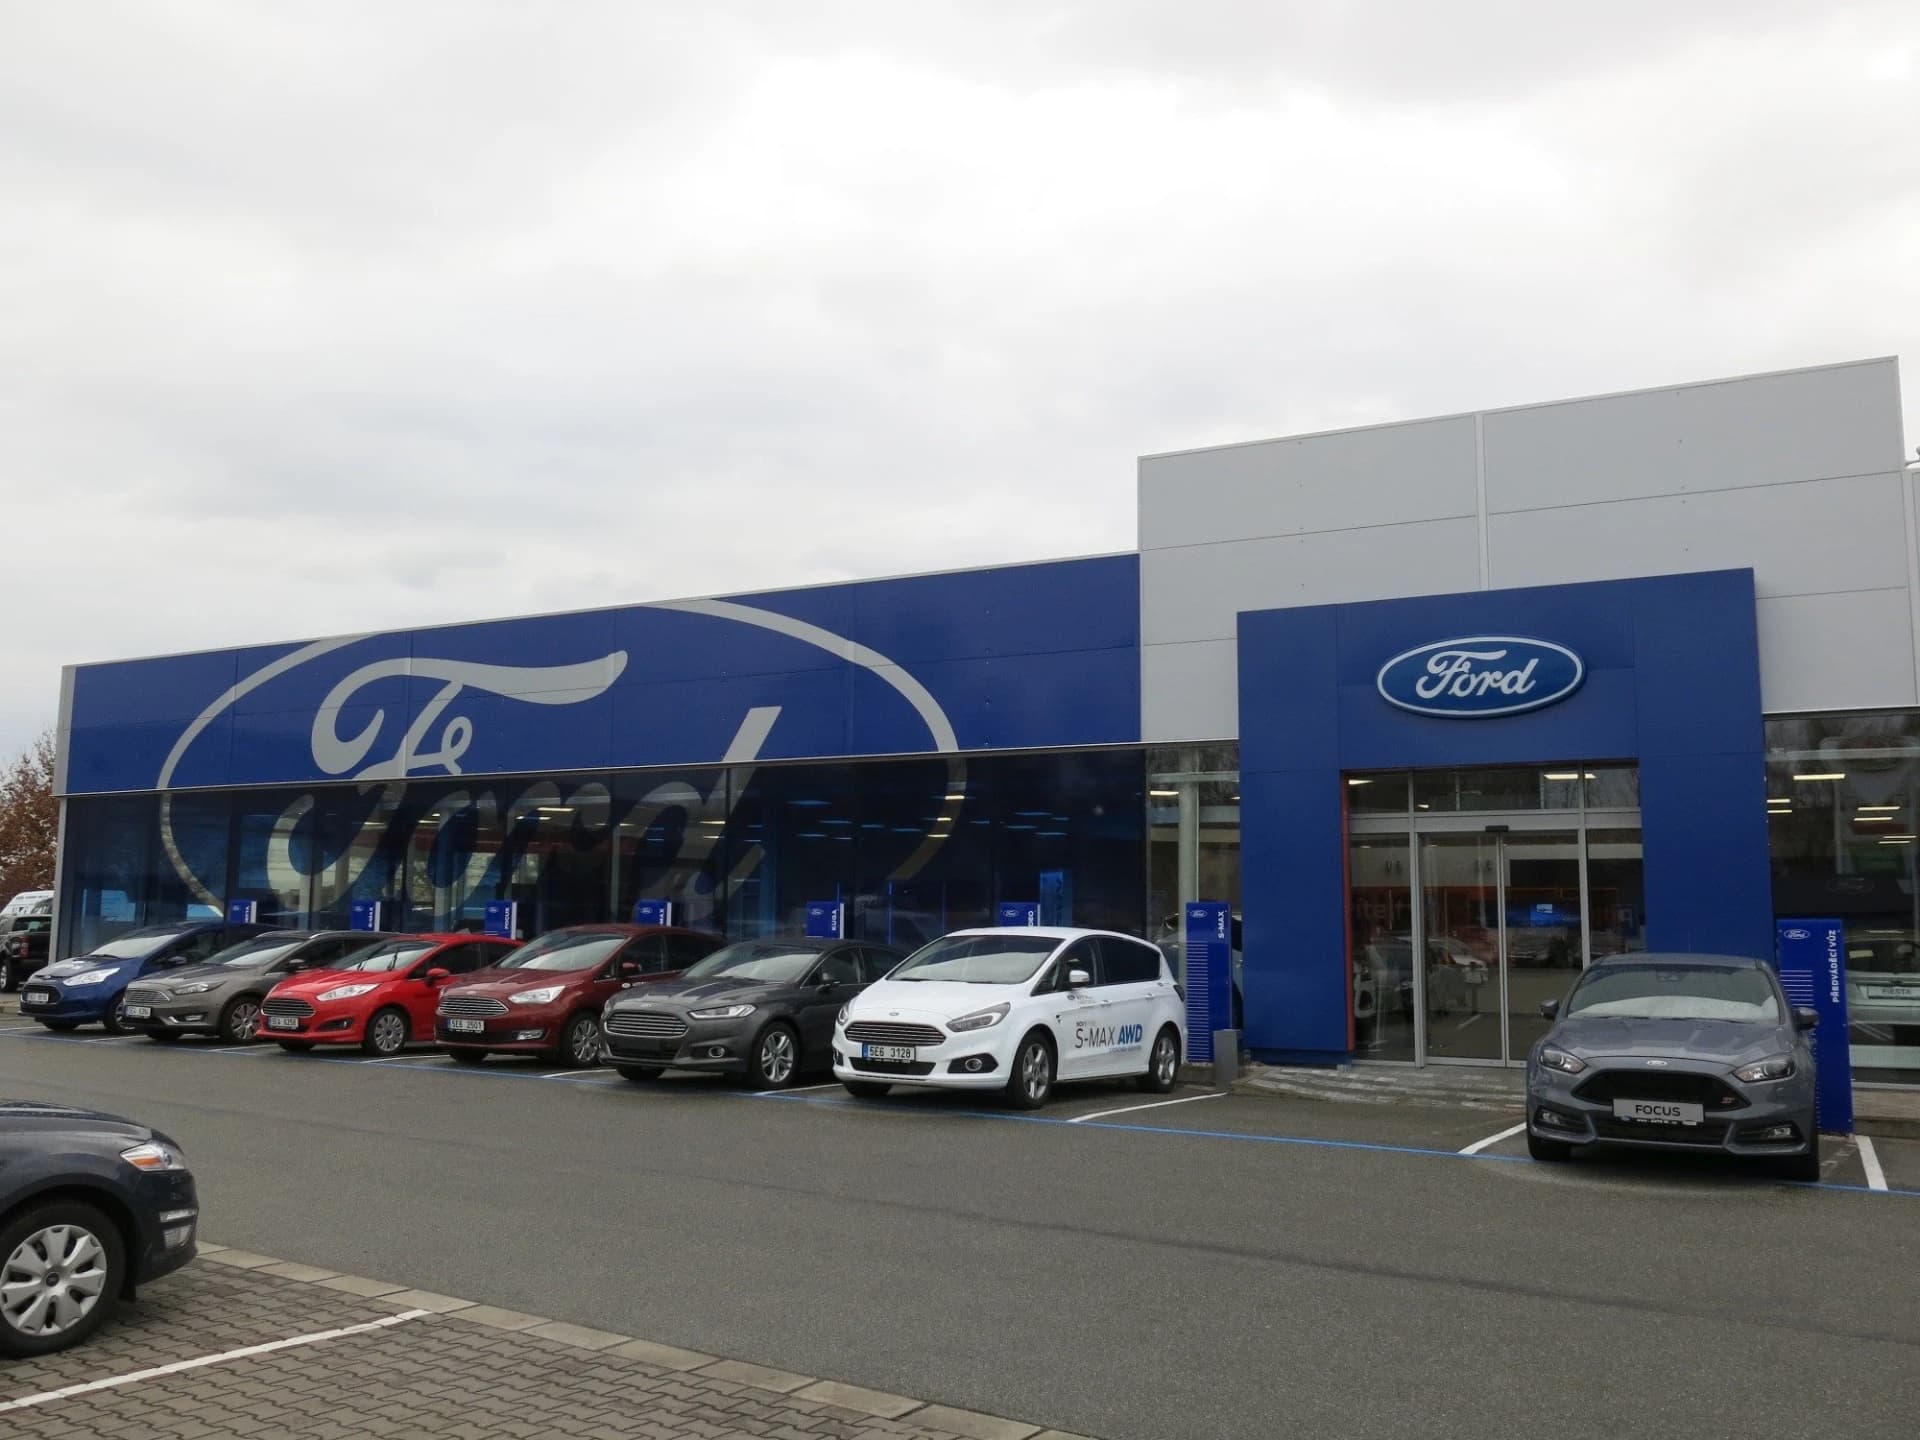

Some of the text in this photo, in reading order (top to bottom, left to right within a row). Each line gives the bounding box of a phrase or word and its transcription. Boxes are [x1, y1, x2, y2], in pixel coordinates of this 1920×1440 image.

[1415, 650, 1539, 699] Ford
[267, 650, 782, 914] Ford
[1826, 929, 1837, 948] VŮZ
[1075, 1024, 1143, 1048] S-MAX AWD
[870, 1046, 911, 1058] 5E6 3128
[1635, 1104, 1681, 1117] FOCUS
